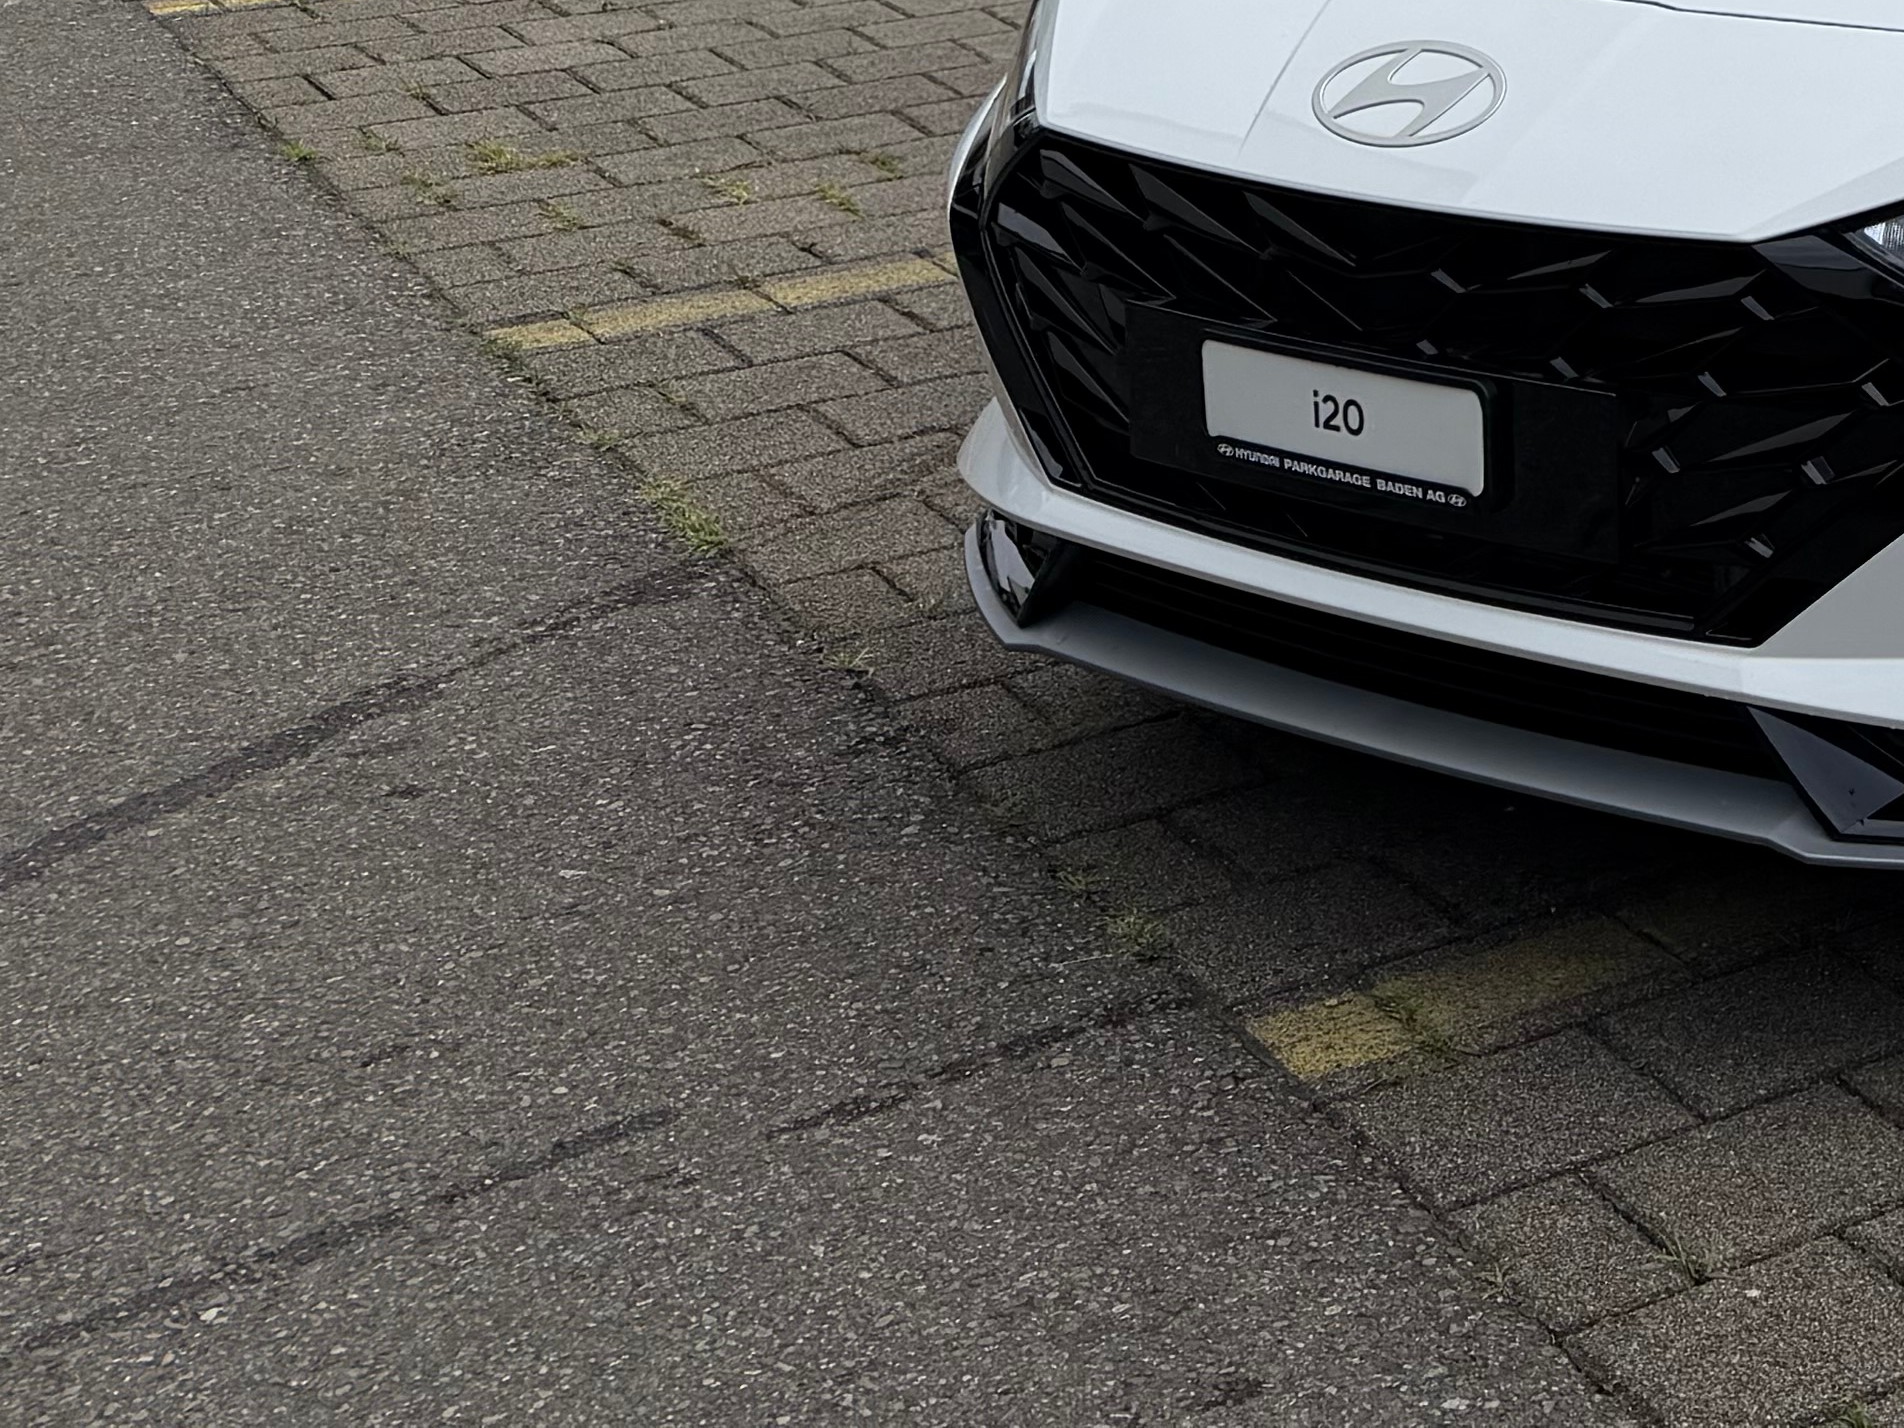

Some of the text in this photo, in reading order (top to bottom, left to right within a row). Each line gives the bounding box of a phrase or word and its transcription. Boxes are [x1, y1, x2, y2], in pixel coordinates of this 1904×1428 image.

[1312, 390, 1364, 436] i20
[1284, 458, 1371, 488] PARKGARAGE
[1376, 479, 1423, 499] BADEN
[1426, 490, 1446, 504] AG
